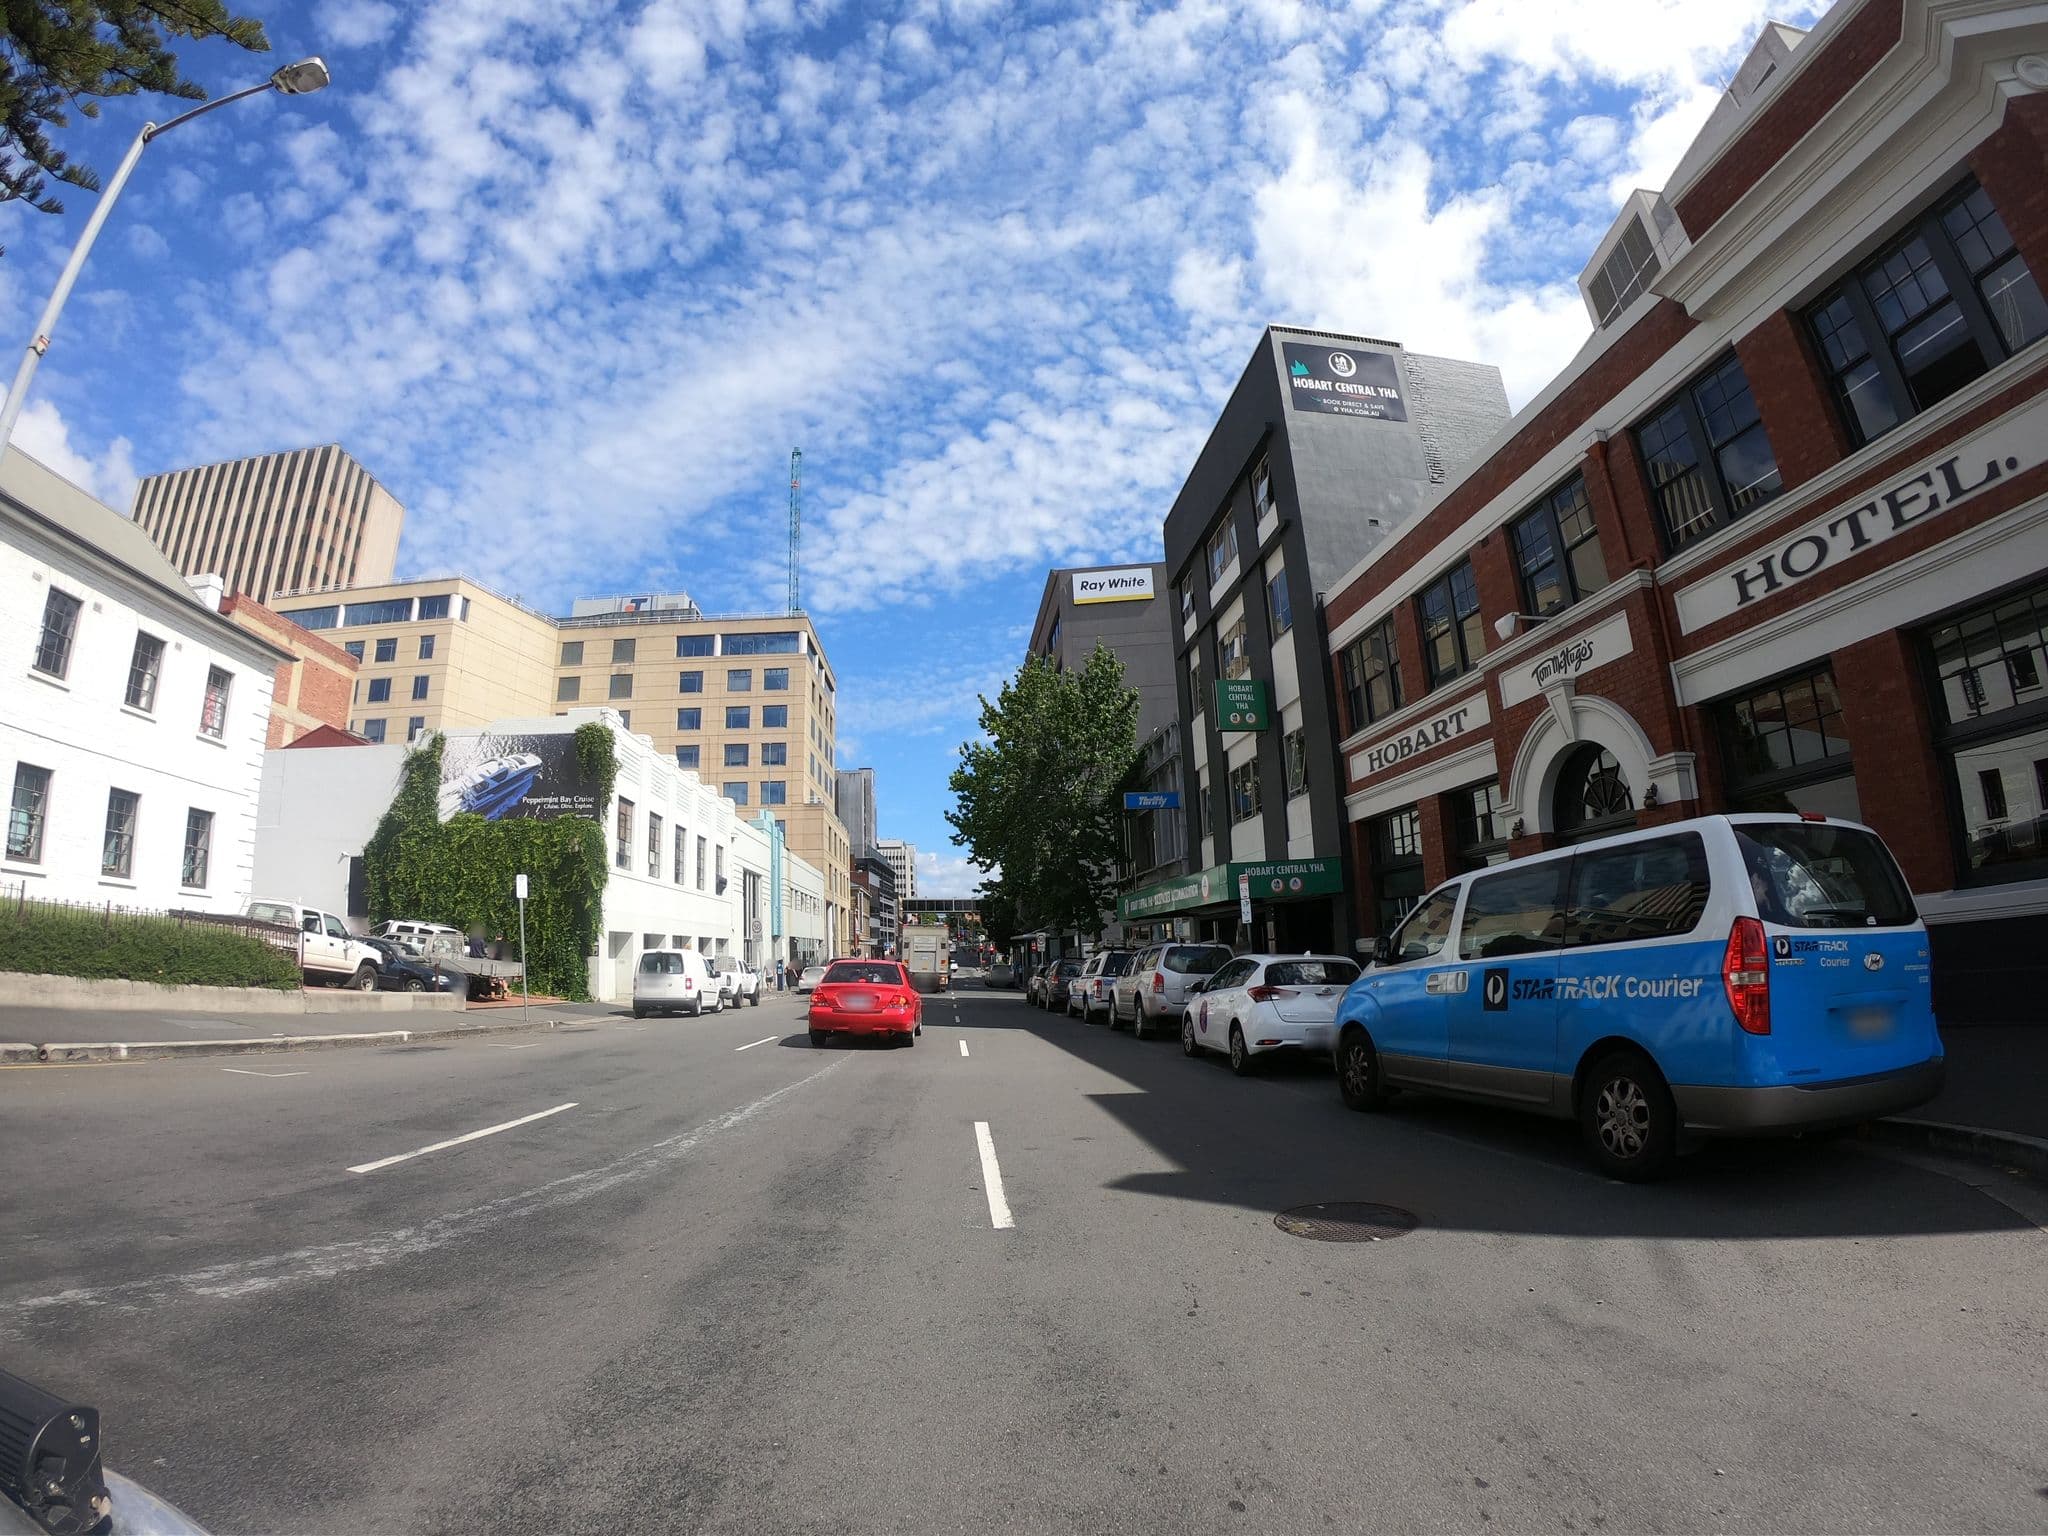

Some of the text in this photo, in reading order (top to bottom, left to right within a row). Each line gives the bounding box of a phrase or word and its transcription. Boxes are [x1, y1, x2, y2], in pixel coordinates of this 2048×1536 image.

[1293, 378, 1398, 399] HOBART CENTRAL YHA
[1343, 400, 1362, 408] DIRECT
[1080, 577, 1145, 591] Ray White
[1531, 657, 1553, 687] Tom
[1228, 693, 1255, 701] CENTRAL
[1236, 702, 1249, 710] YHA
[1367, 707, 1468, 773] HOBART
[523, 795, 594, 805] Peppermint Bay Cruise
[1245, 863, 1325, 876] HOBART CENTRAL YHA
[1794, 940, 1849, 952] STARTRACK
[1820, 956, 1850, 967] Courier
[1511, 973, 1703, 1000] STARTRACK Courier
